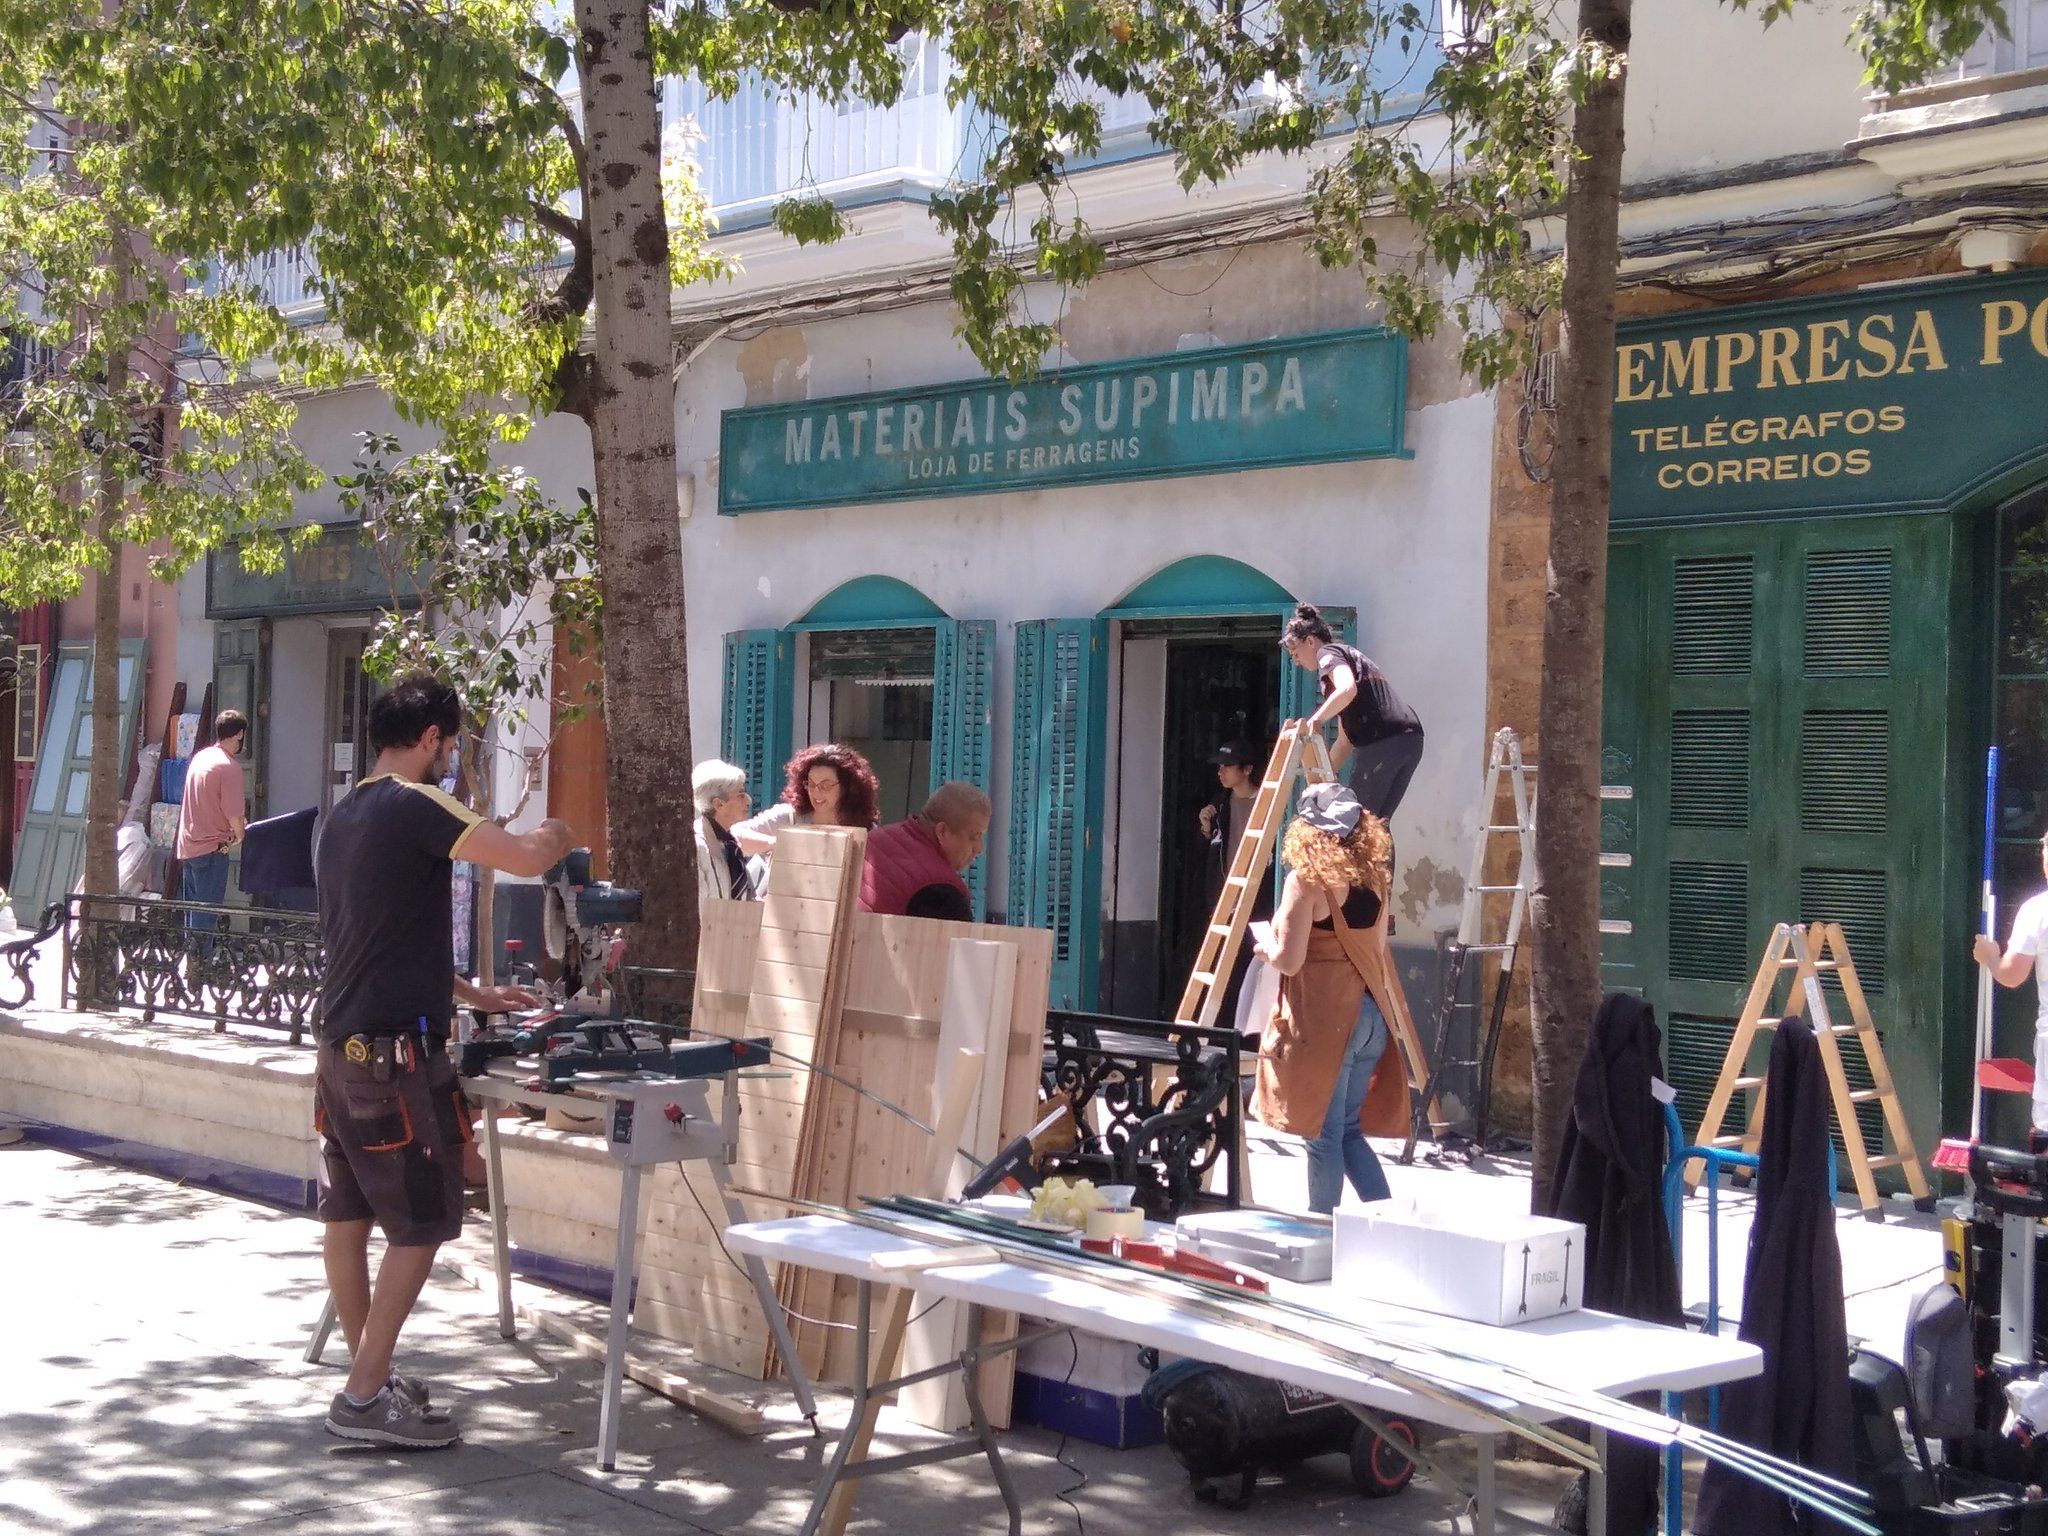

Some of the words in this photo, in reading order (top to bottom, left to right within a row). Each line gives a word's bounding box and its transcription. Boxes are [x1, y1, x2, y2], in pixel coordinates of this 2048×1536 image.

[1615, 310, 1948, 402] EMPRESA
[784, 391, 1028, 466] MATERIAIS
[1059, 357, 1306, 436] SUPIMPA
[1630, 405, 1906, 452] TELÉGRAFOS
[909, 455, 957, 480] LOJA
[968, 451, 994, 473] DE
[1006, 437, 1140, 470] FERRAGENS
[1657, 448, 1872, 489] CORREIOS
